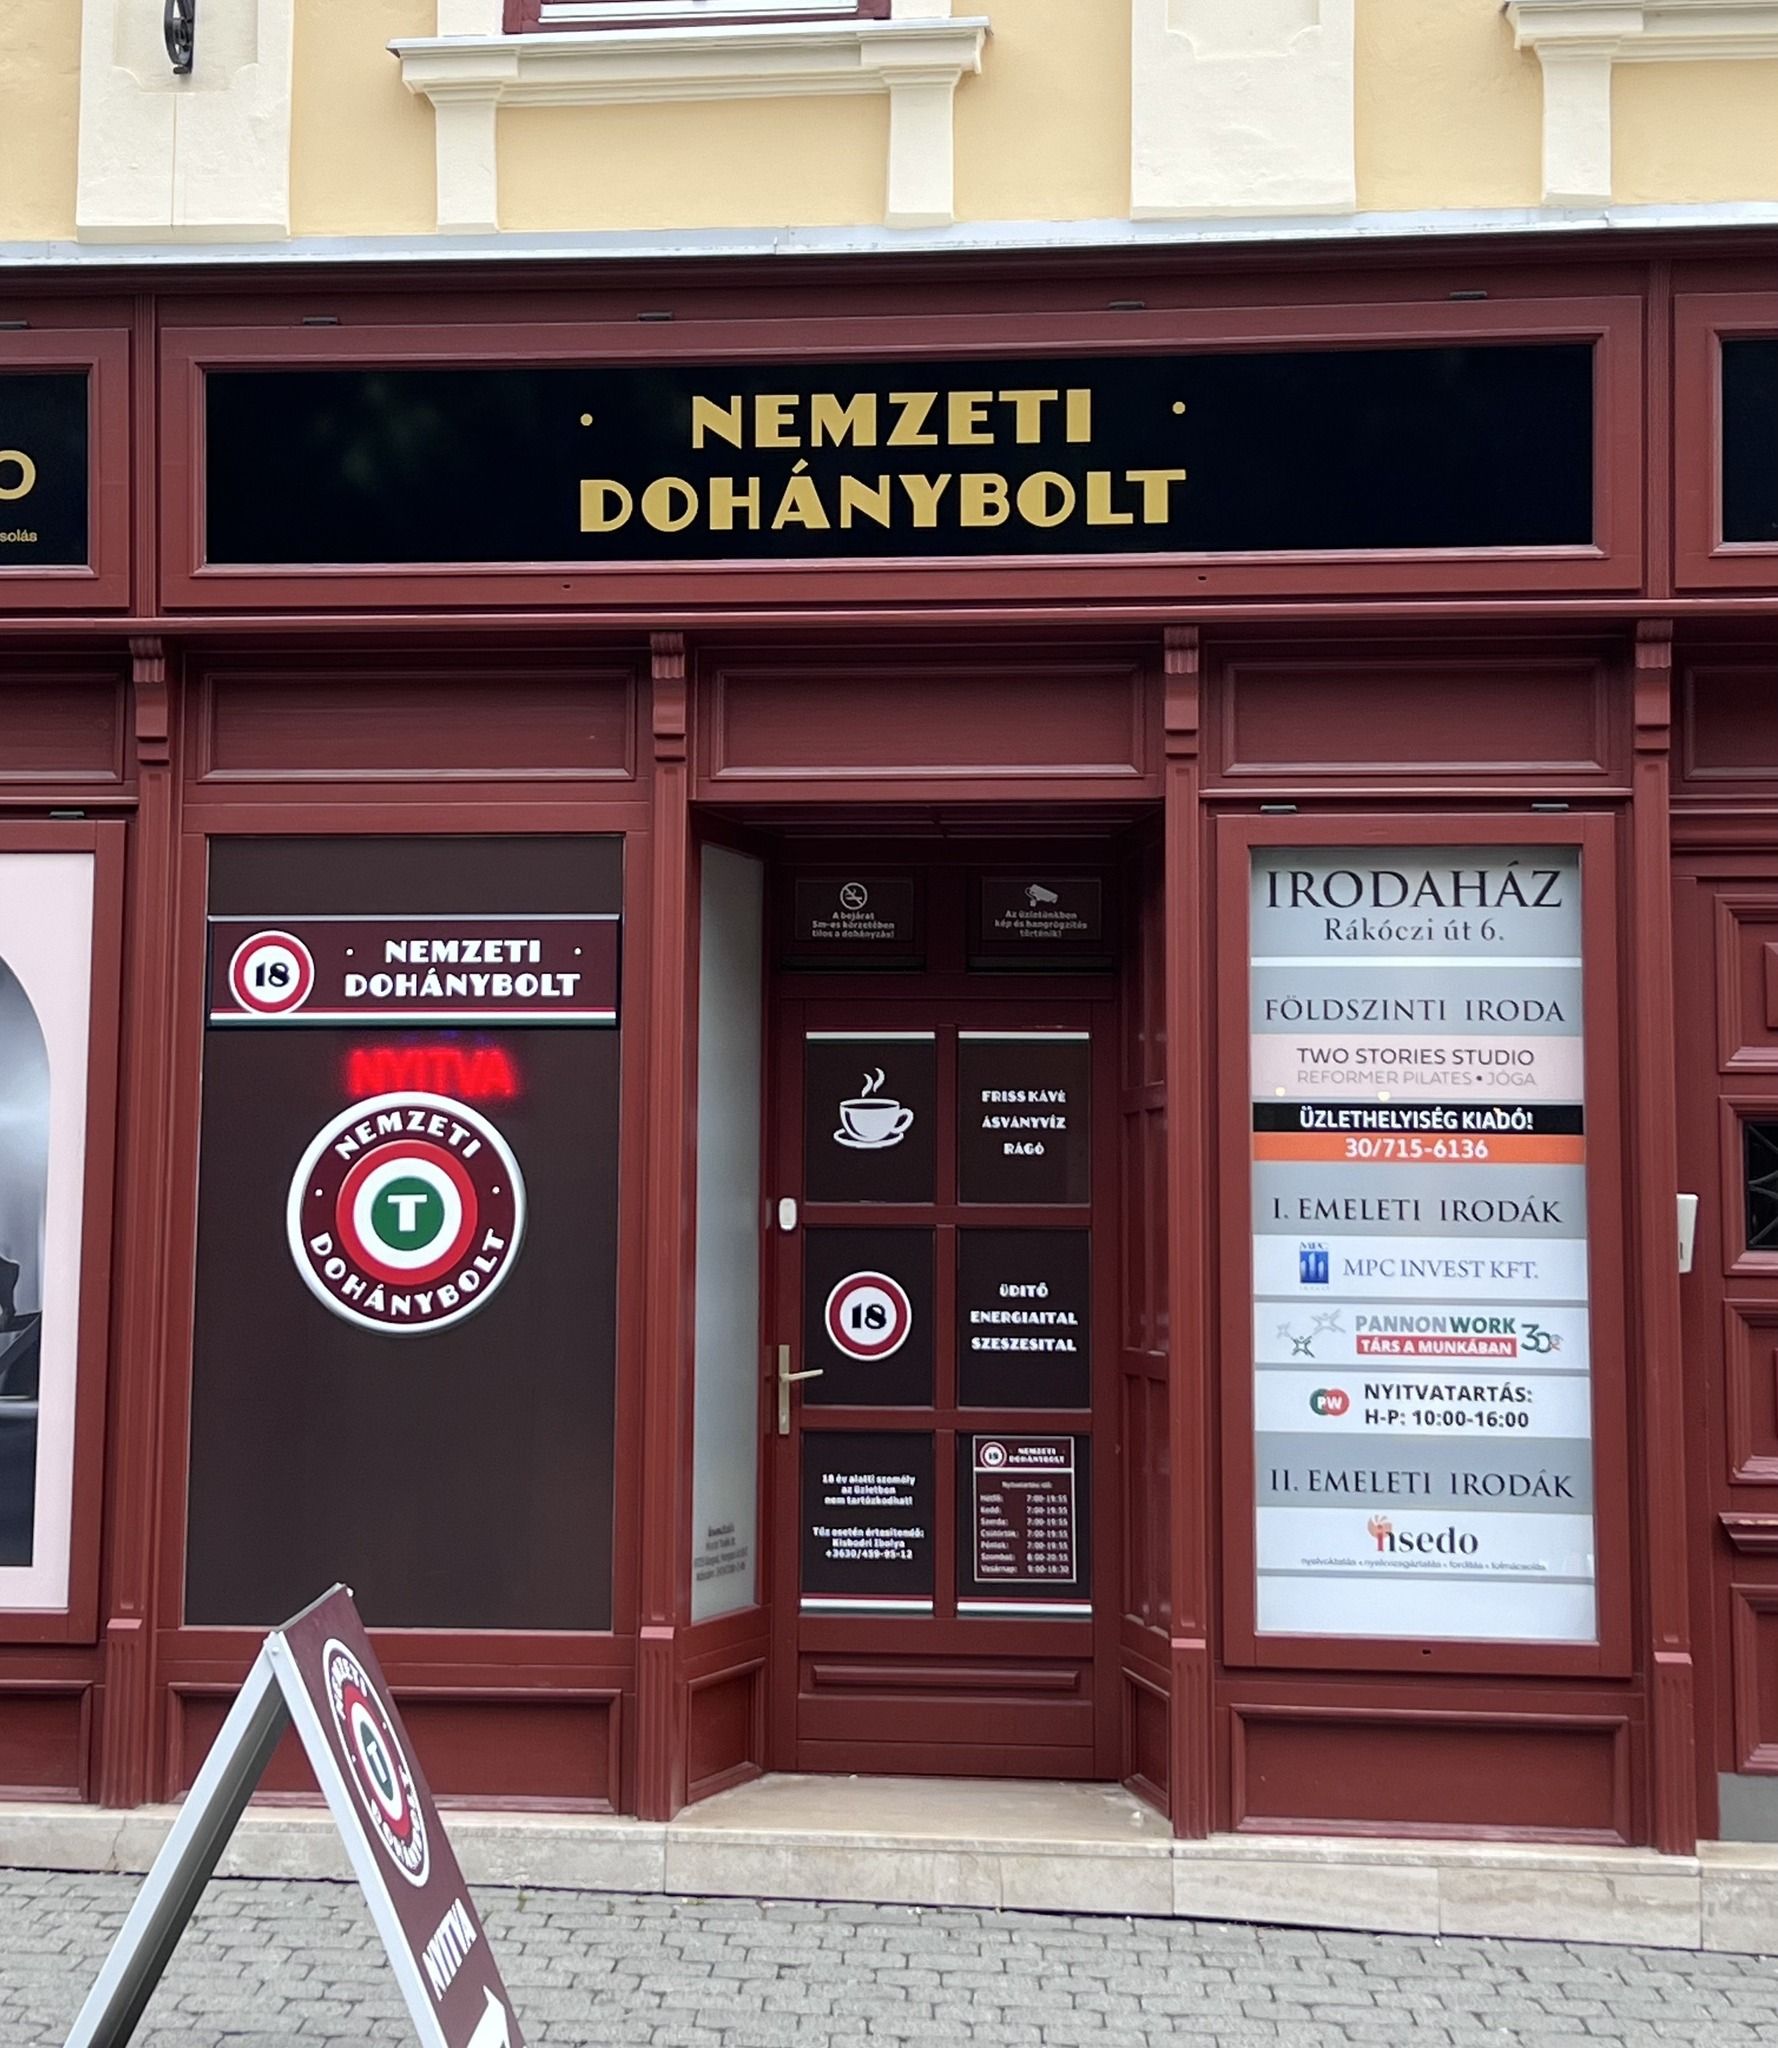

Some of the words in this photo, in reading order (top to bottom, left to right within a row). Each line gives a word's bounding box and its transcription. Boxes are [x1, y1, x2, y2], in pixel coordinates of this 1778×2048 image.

[692, 388, 1091, 449] NEMZETI
[580, 459, 1186, 532] DOHÁNYBOLT
[1266, 860, 1562, 908] IRODAHÁZ
[1324, 916, 1434, 941] Rákóczi
[1444, 918, 1471, 942] út
[1480, 917, 1504, 942] 6.
[384, 939, 541, 963] NEMZETI
[255, 961, 290, 988] 18
[344, 968, 581, 998] DOHÁNYBOLT
[1265, 994, 1447, 1022] FÖLDSZINTI
[1465, 999, 1566, 1022] IRODA
[1297, 1048, 1349, 1065] TWO
[1356, 1048, 1446, 1065] STORIES
[1452, 1048, 1535, 1066] STUDIO
[1297, 1069, 1399, 1085] REFORMER
[1403, 1069, 1472, 1086] PILATES
[1487, 1069, 1537, 1087] JÓGA
[982, 1089, 1027, 1103] FRISS
[1028, 1088, 1067, 1104] KÁVÉ
[982, 1114, 1067, 1130] ÁSVÁNYVÍZ
[1300, 1105, 1458, 1130] ÜZLETHELYISÉG
[1462, 1106, 1534, 1131] KIADÓ!
[335, 1110, 483, 1161] NEMZETI
[1003, 1141, 1045, 1156] RÁGÓ
[1344, 1137, 1489, 1160] 30/715-6136
[387, 1194, 428, 1232] T
[1272, 1197, 1289, 1220] I.
[1298, 1198, 1421, 1222] EMELETI
[1439, 1194, 1564, 1224] IRODÁK
[310, 1228, 506, 1317] DOHÁNYBOLT
[1343, 1258, 1399, 1278] MPC
[1400, 1259, 1485, 1279] INVEST
[1489, 1260, 1540, 1280] KFT.
[851, 1303, 888, 1330] 18
[970, 1310, 1079, 1326] ENERGIAITAL
[971, 1337, 1078, 1353] SZESZESITAL
[1361, 1337, 1401, 1353] TÁRS
[1403, 1340, 1415, 1353] A
[1418, 1338, 1512, 1356] MUNKÁBAN
[1316, 1394, 1344, 1410] PW
[1363, 1382, 1533, 1404] NYITVATARTÁS:
[1364, 1409, 1407, 1427] H-P:
[1411, 1410, 1530, 1428] 10:00-16:00
[822, 1474, 835, 1484] 18
[1270, 1469, 1299, 1493] II.
[1308, 1469, 1431, 1495] EMELETI
[1450, 1468, 1576, 1499] IRODÁK
[422, 1897, 478, 2001] NYITVA
